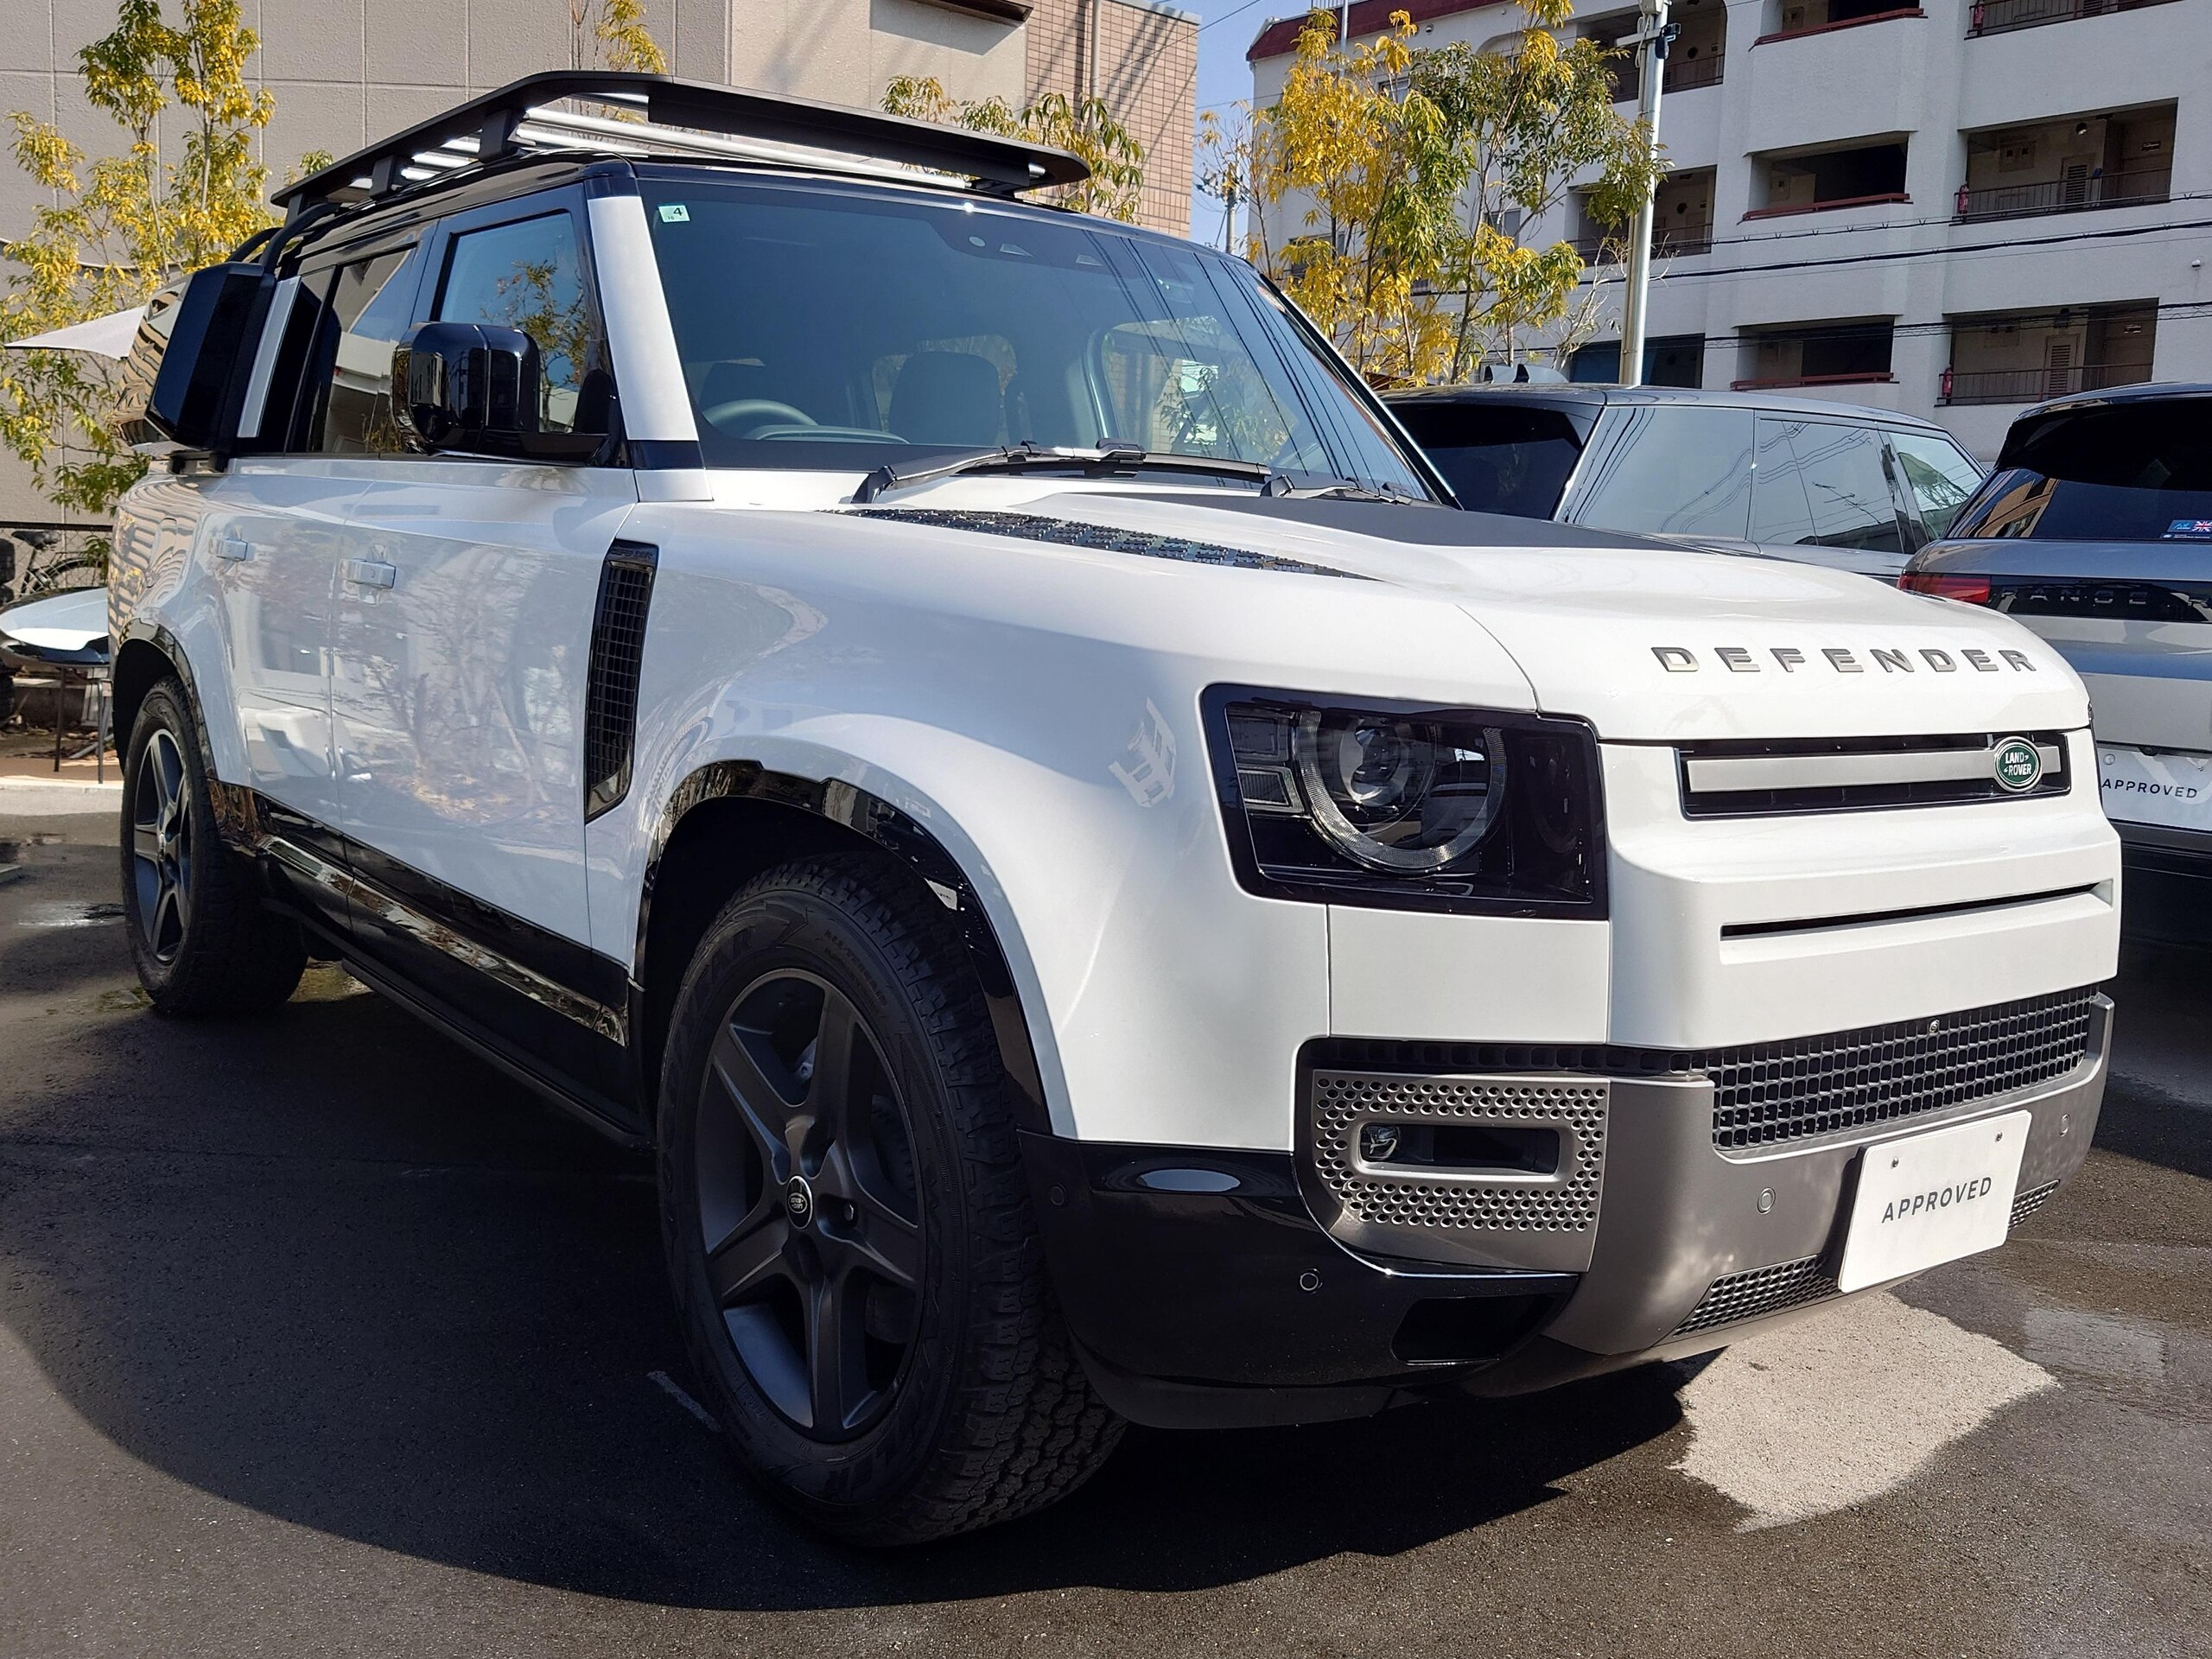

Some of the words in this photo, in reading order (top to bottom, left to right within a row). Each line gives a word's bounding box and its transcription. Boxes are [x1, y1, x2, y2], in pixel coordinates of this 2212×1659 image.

[673, 207, 683, 216] 4
[1650, 646, 2037, 673] DEFENDER
[2005, 752, 2024, 764] LAND
[2008, 764, 2032, 776] ROVER
[2101, 779, 2197, 798] APPROVED
[1881, 1176, 1993, 1224] APPROVED
